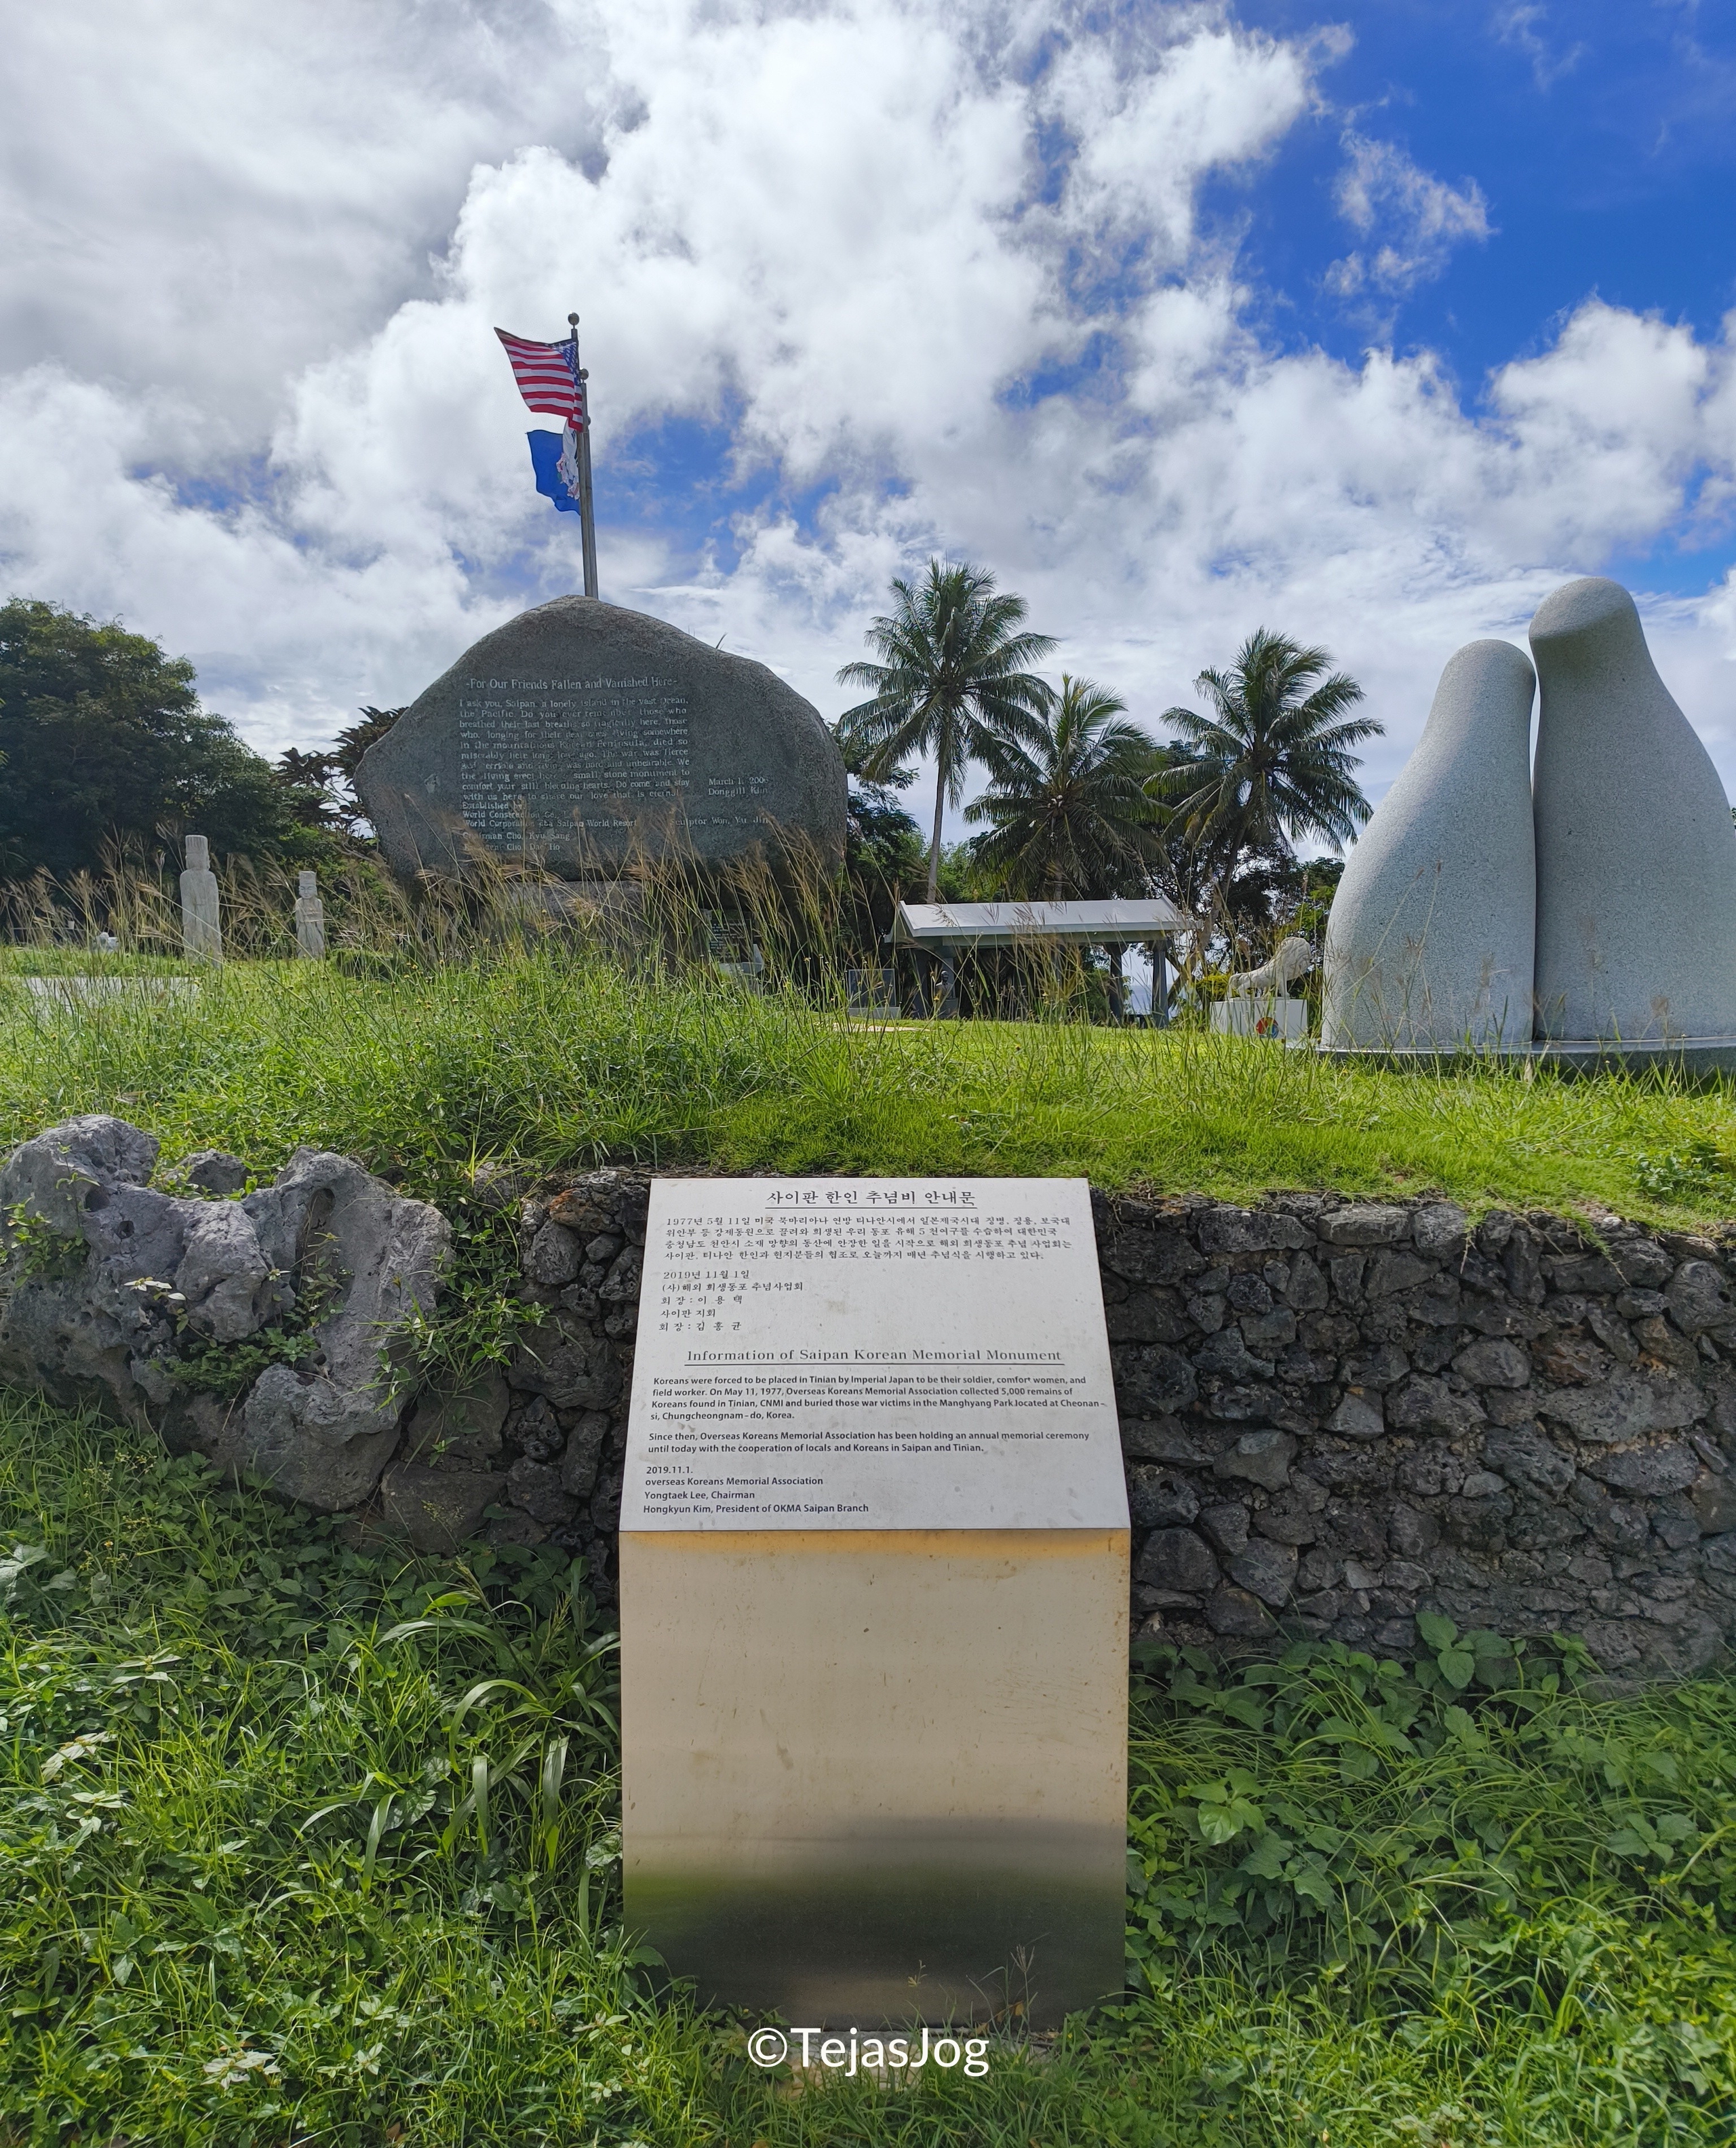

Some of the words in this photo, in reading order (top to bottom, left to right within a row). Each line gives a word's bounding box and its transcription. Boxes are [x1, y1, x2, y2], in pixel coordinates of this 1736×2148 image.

[490, 678, 508, 689] Our
[511, 679, 548, 690] Friends
[551, 679, 582, 690] Fallen
[585, 678, 601, 689] and
[605, 676, 649, 688] Vanished
[550, 700, 576, 709] lonely
[643, 728, 688, 736] somewhere
[709, 777, 734, 785] March
[766, 1190, 819, 1205] 사이판
[825, 1190, 858, 1205] 한인
[865, 1190, 915, 1205] 추념비
[924, 1190, 976, 1207] 안내문
[663, 1270, 701, 1280] 2019년
[705, 1270, 729, 1280] 11월
[734, 1270, 749, 1279] 1일
[705, 1283, 748, 1293] 희생동포
[751, 1281, 803, 1291] 추념사업회
[660, 1308, 692, 1319] 사이판
[695, 1308, 715, 1319] 지회
[688, 1350, 774, 1361] Information
[780, 1349, 795, 1360] of
[800, 1349, 848, 1362] Saipan
[854, 1349, 907, 1360] Korean
[912, 1349, 981, 1360] Memorial
[986, 1350, 1061, 1361] Monument
[653, 1377, 689, 1385] Koreans
[714, 1375, 743, 1384] forced
[755, 1375, 767, 1384] be
[768, 1375, 797, 1386] placed
[799, 1375, 808, 1384] in
[809, 1375, 837, 1384] Tinian
[838, 1375, 850, 1386] by
[851, 1375, 887, 1386] Imperial
[888, 1375, 915, 1386] Japan
[927, 1375, 939, 1384] be
[940, 1375, 962, 1384] their
[962, 1375, 995, 1384] soldier,
[996, 1375, 1031, 1384] comfort
[1069, 1375, 1086, 1384] and
[652, 1388, 673, 1397] field
[674, 1388, 708, 1397] worker.
[709, 1388, 722, 1396] On
[724, 1388, 743, 1397] May
[745, 1388, 758, 1397] 11,
[760, 1387, 785, 1397] 1977,
[785, 1387, 826, 1396] Overseas
[827, 1386, 864, 1395] Koreans
[865, 1387, 907, 1395] Memorial
[908, 1387, 958, 1395] Association
[960, 1387, 1000, 1396] collected
[1001, 1387, 1025, 1397] 5,000
[1027, 1388, 1063, 1396] remains
[1063, 1387, 1073, 1396] of
[689, 1399, 716, 1408] found
[717, 1399, 726, 1407] in
[728, 1399, 758, 1409] Tinian,
[760, 1399, 783, 1407] CNMI
[785, 1399, 803, 1407] and
[804, 1398, 833, 1407] buried
[835, 1399, 860, 1407] those
[880, 1398, 911, 1407] victims
[913, 1399, 922, 1407] in
[922, 1399, 938, 1407] the
[939, 1399, 992, 1409] Manghyang
[993, 1399, 1014, 1407] Park
[1014, 1399, 1048, 1407] located
[650, 1412, 660, 1421] si,
[766, 1411, 795, 1420] Korea.
[648, 1432, 673, 1441] Since
[674, 1432, 698, 1441] then,
[700, 1432, 741, 1441] Overseas
[742, 1432, 778, 1440] Koreans
[780, 1431, 823, 1440] Memorial
[825, 1431, 875, 1440] Association
[877, 1431, 893, 1440] has
[894, 1431, 918, 1440] been
[919, 1431, 953, 1441] holding
[968, 1431, 1000, 1439] annual
[1001, 1431, 1044, 1439] memorial
[1045, 1433, 1090, 1441] ceremony
[648, 1444, 669, 1453] until
[671, 1444, 697, 1454] today
[698, 1444, 719, 1453] with
[721, 1444, 736, 1452] the
[738, 1443, 793, 1454] cooperation
[794, 1443, 805, 1452] of
[806, 1443, 831, 1452] locals
[833, 1443, 851, 1452] and
[853, 1443, 889, 1452] Koreans
[891, 1443, 900, 1452] in
[901, 1443, 932, 1453] Saipan
[934, 1443, 951, 1451] and
[952, 1443, 984, 1452] Tinian.
[646, 1466, 693, 1475] 2019.11.1.
[687, 1477, 724, 1485] Koreans
[726, 1477, 770, 1485] Memorial
[771, 1477, 823, 1485] Association
[644, 1490, 688, 1502] Yongtaek
[690, 1491, 709, 1500] Lee,
[711, 1490, 755, 1500] Chairman
[643, 1504, 691, 1515] Hongkyun
[693, 1504, 713, 1514] Kim,
[715, 1504, 760, 1513] President
[761, 1504, 772, 1513] of
[773, 1504, 802, 1512] OKMA
[804, 1504, 835, 1515] Saipan
[837, 1503, 869, 1512] Branch
